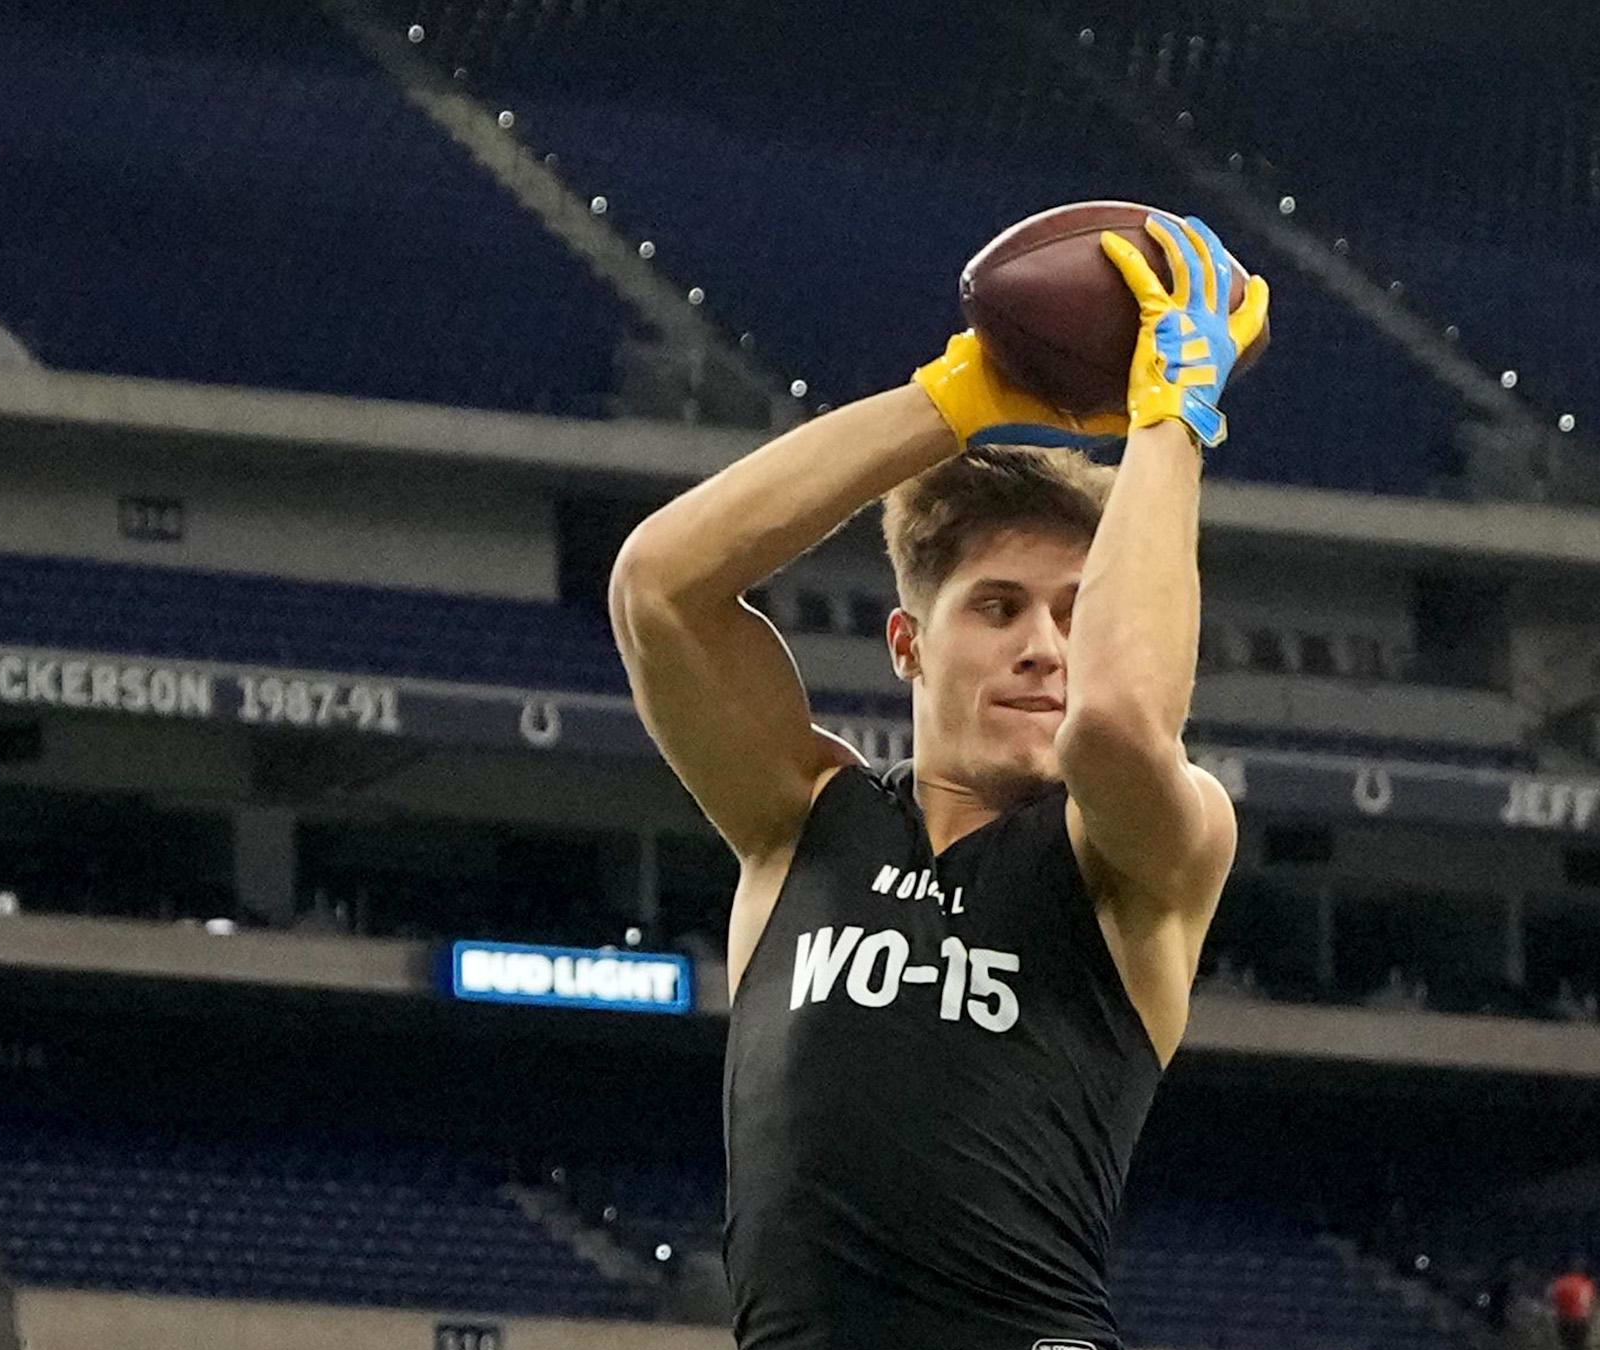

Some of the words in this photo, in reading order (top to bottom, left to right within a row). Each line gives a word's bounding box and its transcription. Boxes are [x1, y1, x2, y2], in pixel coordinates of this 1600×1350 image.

[237, 676, 400, 733] 1987-91
[1501, 779, 1600, 830] JEFF
[461, 950, 553, 995] BUD
[554, 956, 678, 1003] LIGHT
[790, 926, 1020, 1033] WO-15
